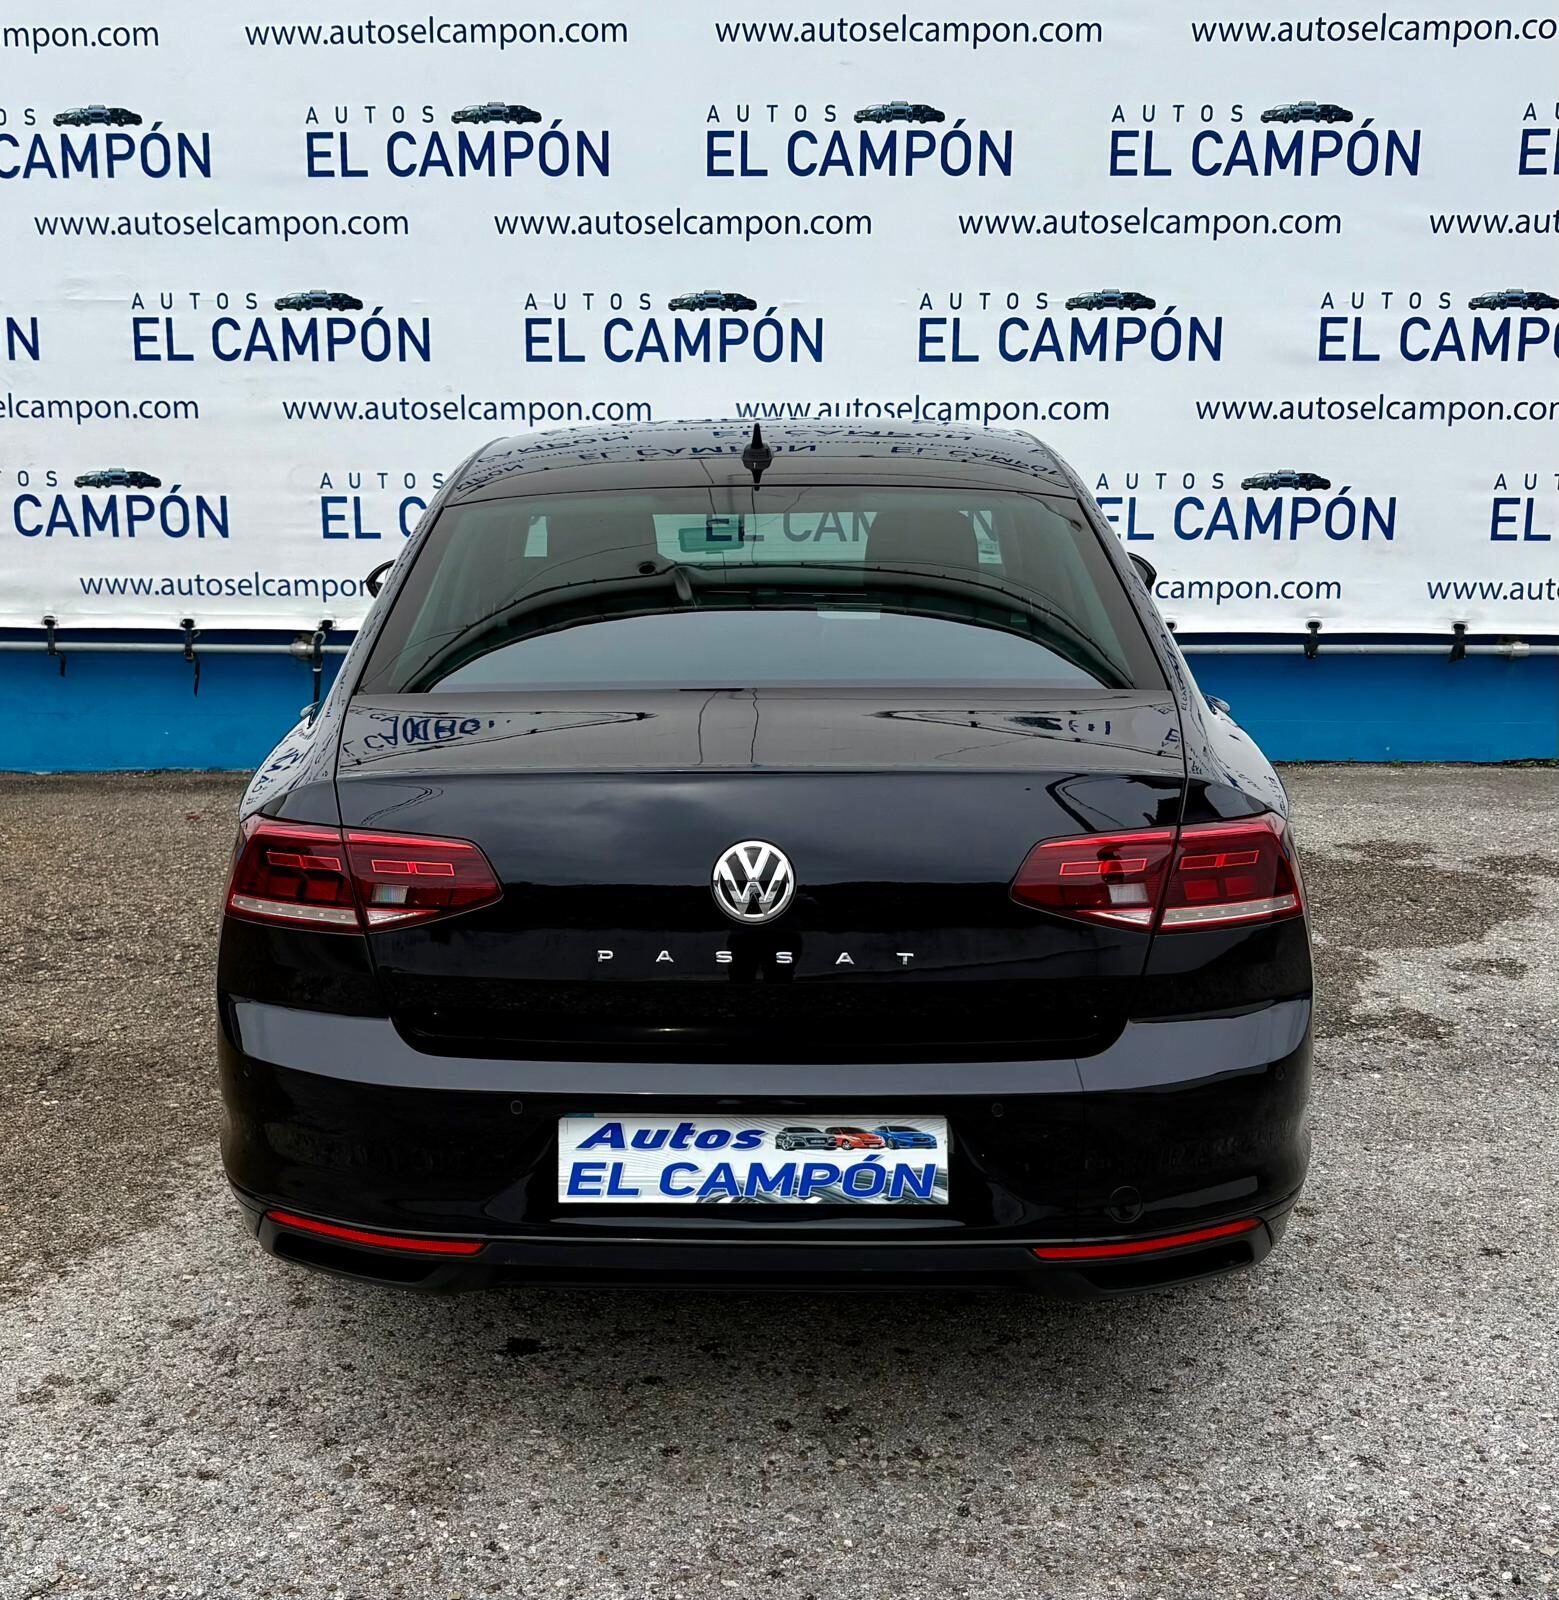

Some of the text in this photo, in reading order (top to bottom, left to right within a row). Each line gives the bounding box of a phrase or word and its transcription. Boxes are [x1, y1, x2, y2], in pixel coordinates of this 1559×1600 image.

[245, 16, 628, 49] www.autoselcampon.com
[715, 14, 1103, 49] www.autoselcampon.com
[1192, 13, 1557, 47] www.autoselcampon.co
[306, 105, 434, 124] AUTOS
[707, 104, 836, 123] AUTOS
[1112, 103, 1242, 122] AUTOS
[0, 122, 211, 179] CAMPÓN
[306, 120, 609, 177] EL CAMPÓN
[707, 119, 1012, 177] EL CAMPÓN
[1110, 117, 1421, 176] EL CAMPÓN
[34, 208, 408, 242] www.autoselcampon.com
[494, 208, 872, 242] www.autoselcampon.com
[959, 207, 1341, 241] www.autoselcampon.com
[132, 292, 257, 310] AUTOS
[524, 292, 651, 310] AUTOS
[920, 292, 1048, 310] AUTOS
[1321, 291, 1450, 309] AUTOS
[133, 308, 430, 362] EL CAMPÓN
[525, 307, 823, 363] EL CAMPÓN
[919, 306, 1222, 362] EL CAMPÓN
[1318, 316, 1559, 361] EL CAMP
[282, 394, 652, 427] www.autoselcampon.com
[735, 394, 1110, 425] wwwautoselcampon.com
[320, 472, 443, 490] AUTOS
[1096, 473, 1223, 490] AUTOS
[14, 485, 229, 538] CAMPÓN
[321, 496, 381, 539] EL
[1174, 486, 1396, 540] CAMPÓN
[1490, 497, 1552, 541] EL
[1427, 576, 1559, 600] www.aut
[597, 949, 915, 966] PASSAT
[576, 1121, 765, 1152] Autos
[567, 1154, 936, 1199] EL CAMPÓN
